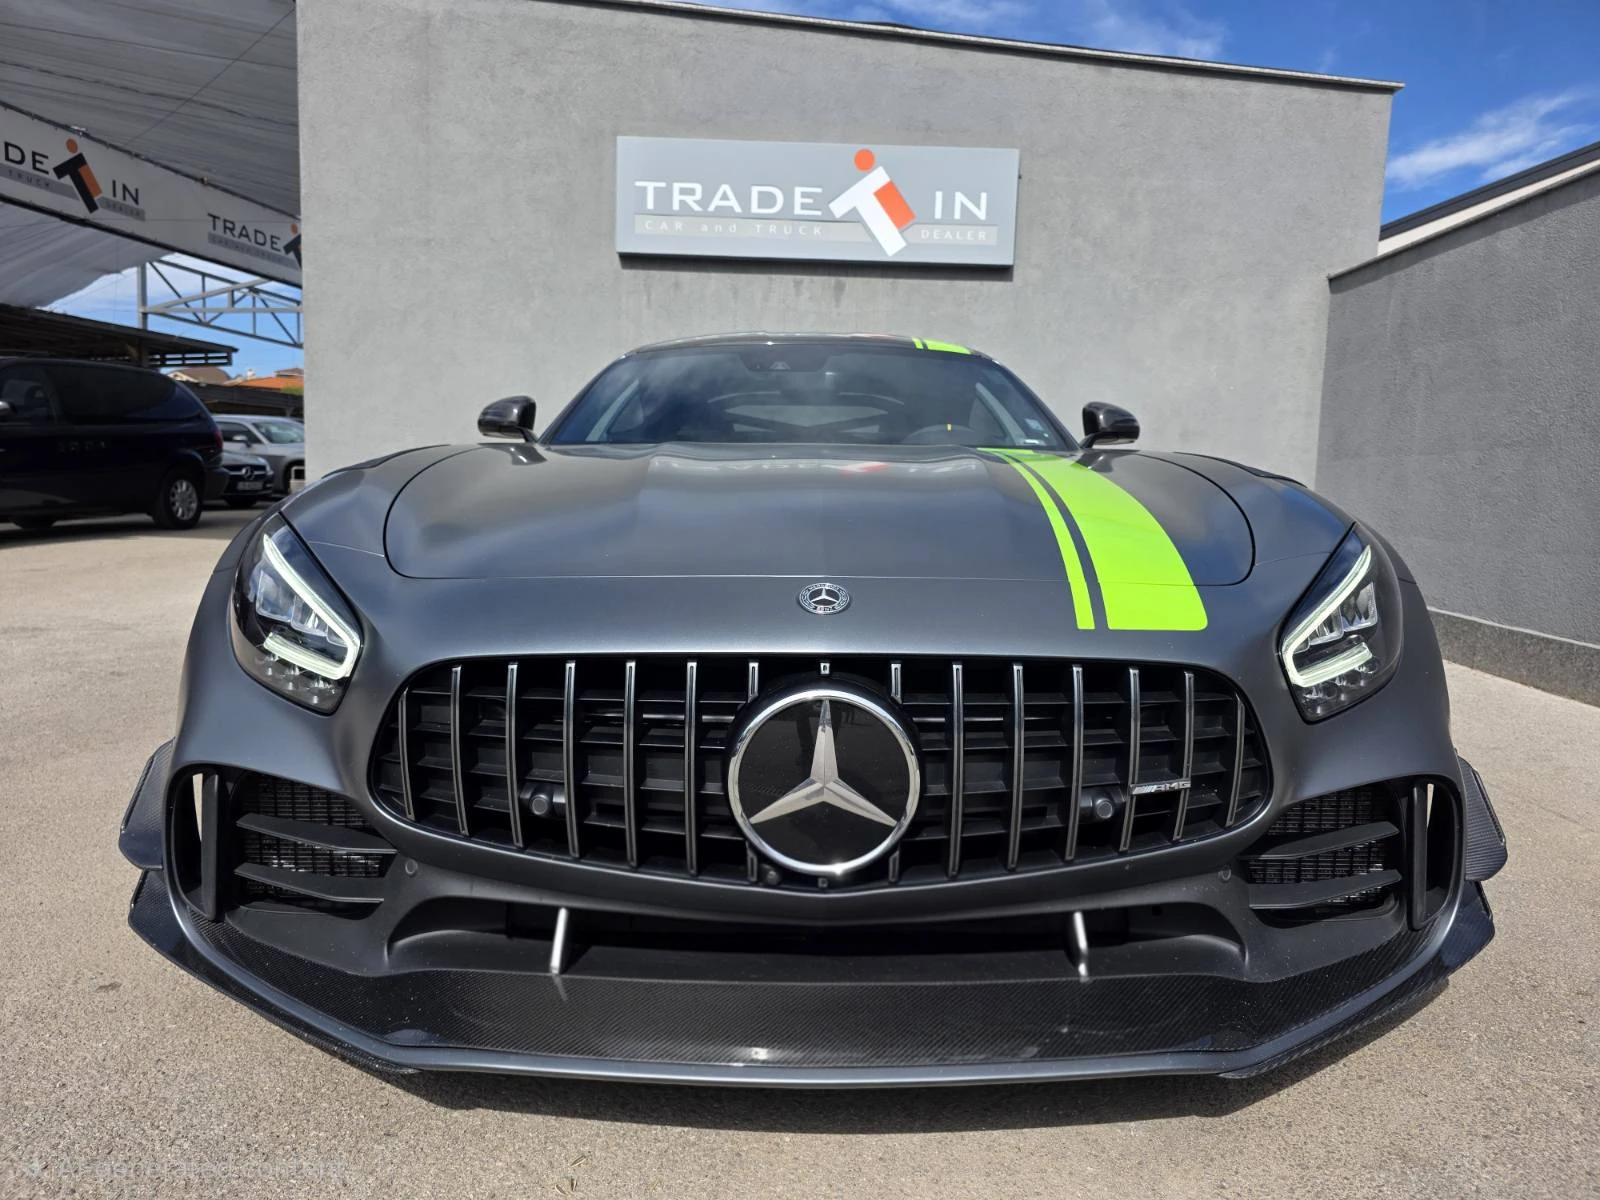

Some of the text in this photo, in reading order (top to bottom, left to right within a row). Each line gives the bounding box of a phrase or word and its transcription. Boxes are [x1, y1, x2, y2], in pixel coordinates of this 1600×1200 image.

[111, 179, 140, 206] IN
[634, 180, 823, 217] TRADE
[934, 190, 989, 221] IN
[207, 212, 282, 253] TRADE
[644, 219, 988, 241] CAR and TRUCK DEALER
